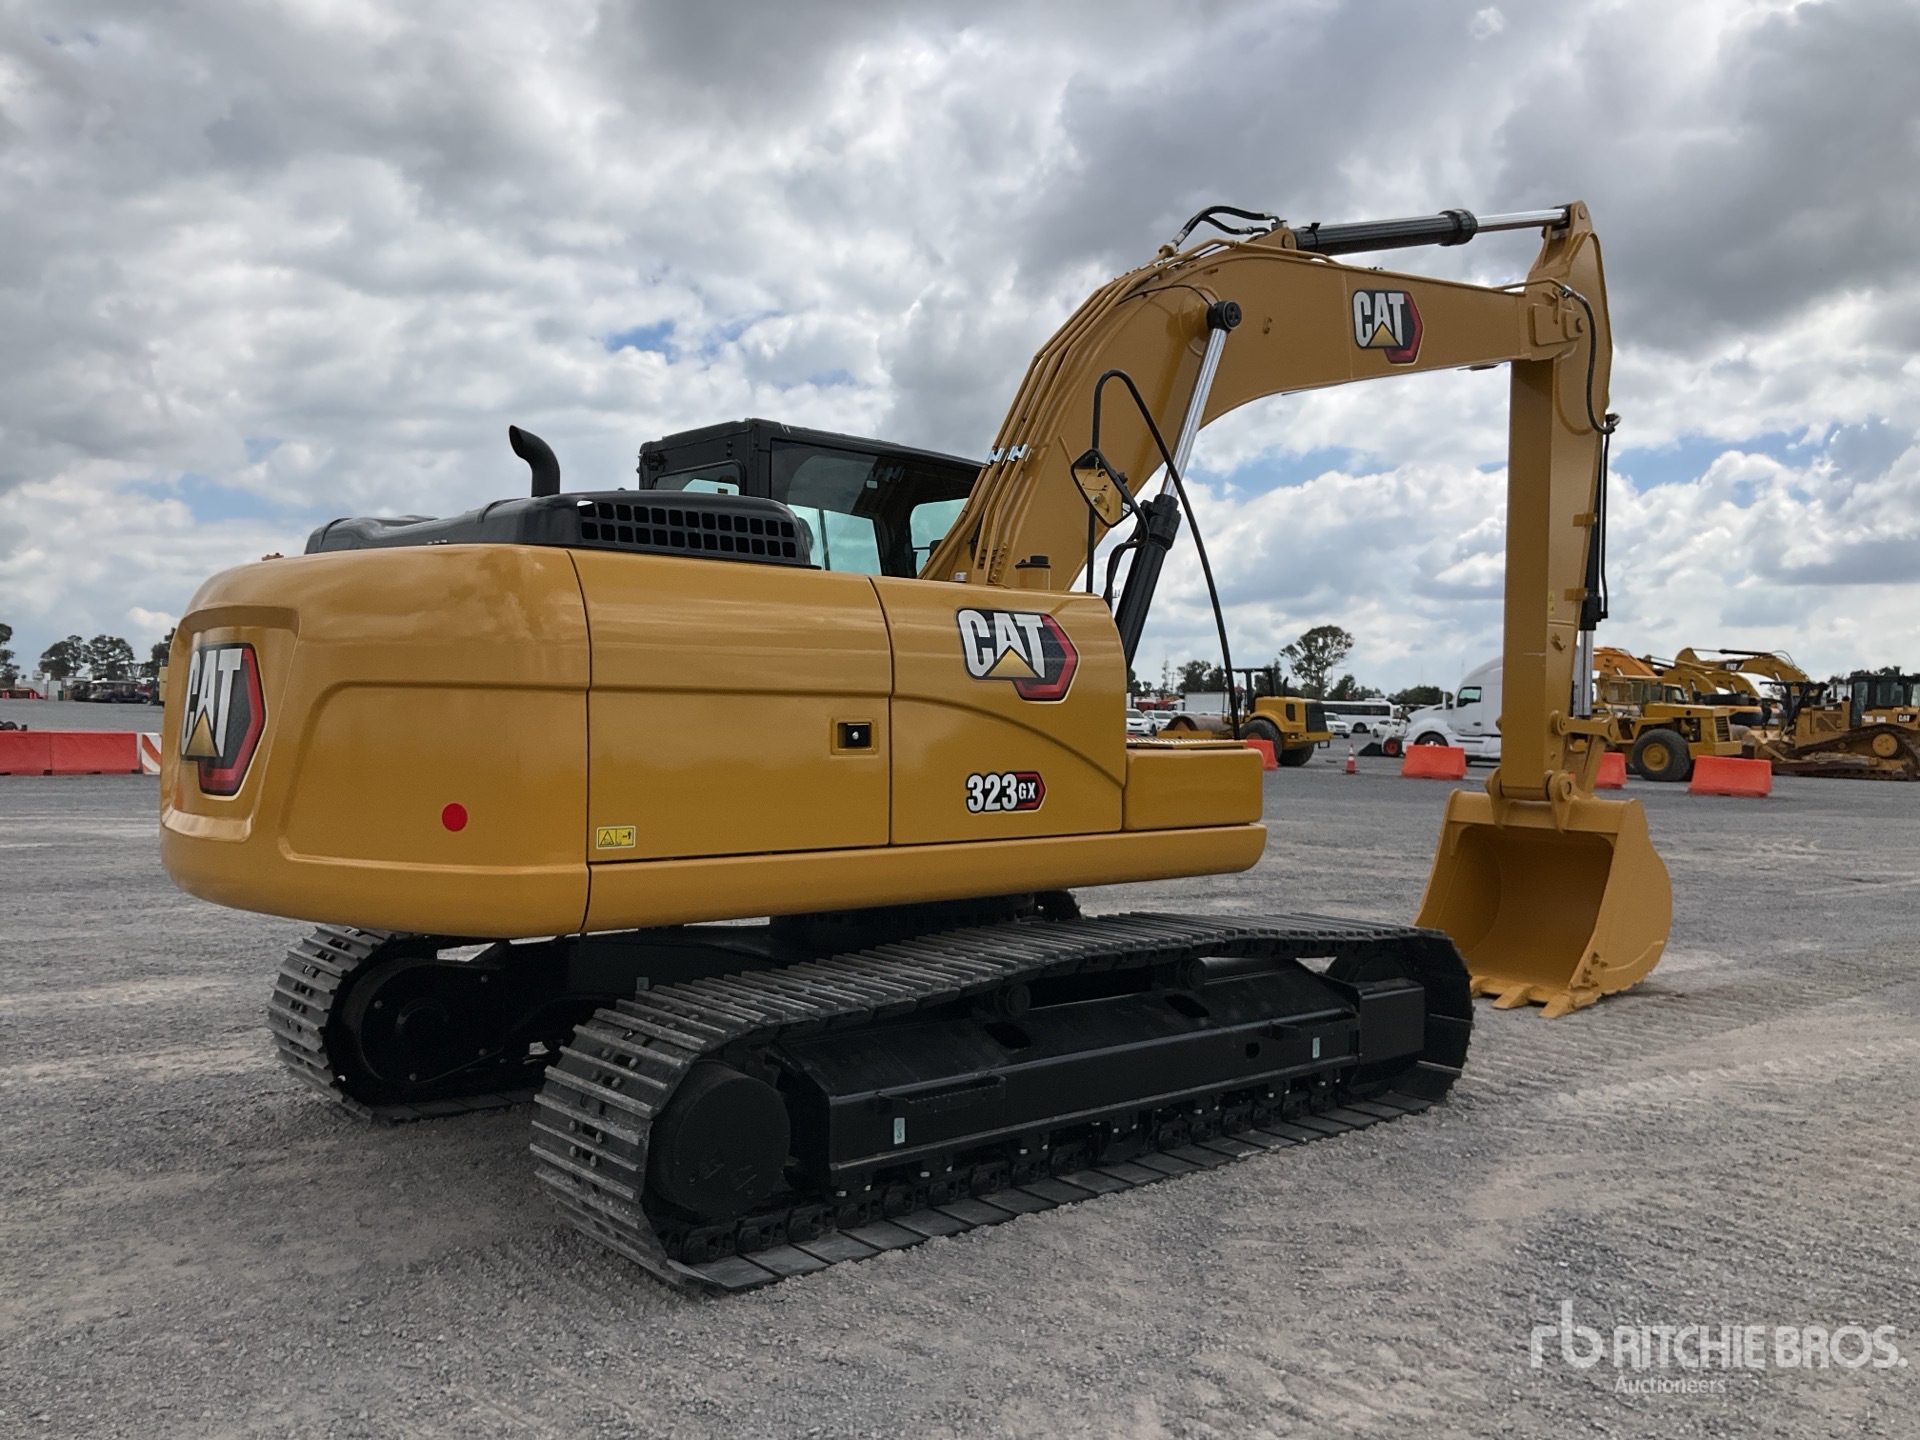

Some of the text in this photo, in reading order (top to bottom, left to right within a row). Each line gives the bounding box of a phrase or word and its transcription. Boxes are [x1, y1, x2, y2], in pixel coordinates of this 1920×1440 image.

[1353, 291, 1405, 347] CAT
[958, 609, 1045, 678] CAT
[181, 648, 243, 757] CAT
